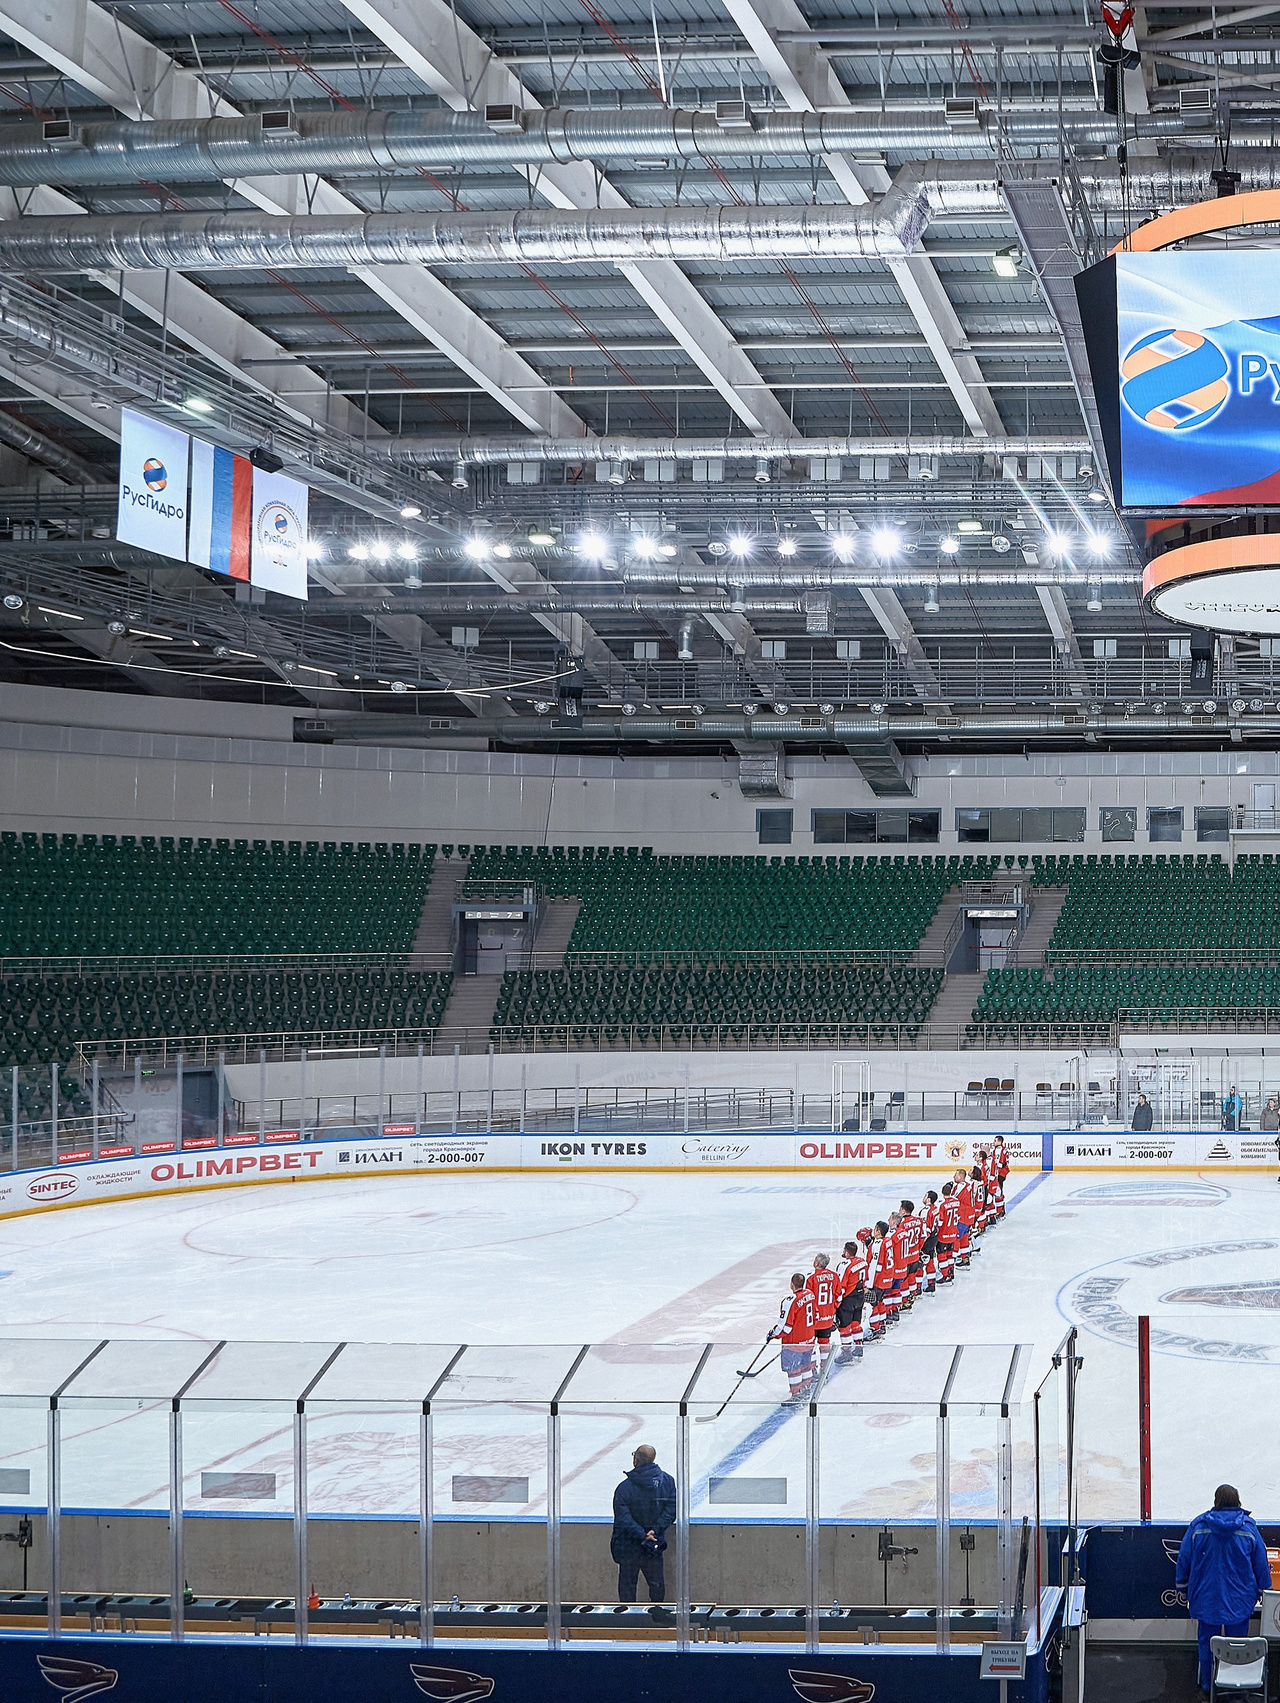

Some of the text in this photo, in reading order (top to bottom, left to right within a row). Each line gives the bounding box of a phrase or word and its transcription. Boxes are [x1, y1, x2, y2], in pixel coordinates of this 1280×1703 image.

[122, 485, 184, 520] РусГидро
[264, 531, 297, 549] РусГидро
[184, 1139, 216, 1147] OLIMPBET
[225, 1136, 258, 1144] OLIMPBET
[266, 1133, 298, 1141] OLIMPBET
[100, 1147, 133, 1156] OLIMPBET
[142, 1143, 175, 1151] OLIMPBET
[541, 1143, 647, 1155] IKON TYRES
[681, 1138, 750, 1160] Catering
[800, 1143, 938, 1158] OLIMPBET
[1077, 1148, 1112, 1156] ИЛАН
[59, 1152, 91, 1161] OLIMPBET
[355, 1151, 403, 1164] ИЛАН
[427, 1152, 485, 1164] 2-000-007
[1129, 1150, 1173, 1159] 2-000-007
[150, 1150, 323, 1182] OLIMPBET
[87, 1170, 142, 1181] ОХЛАЖДАЮЩИЕ
[95, 1176, 133, 1186] ЖИДКОСТИ
[29, 1180, 76, 1195] SINTEC
[907, 1227, 920, 1248] 23
[817, 1282, 834, 1306] 61
[806, 1302, 814, 1328] 8
